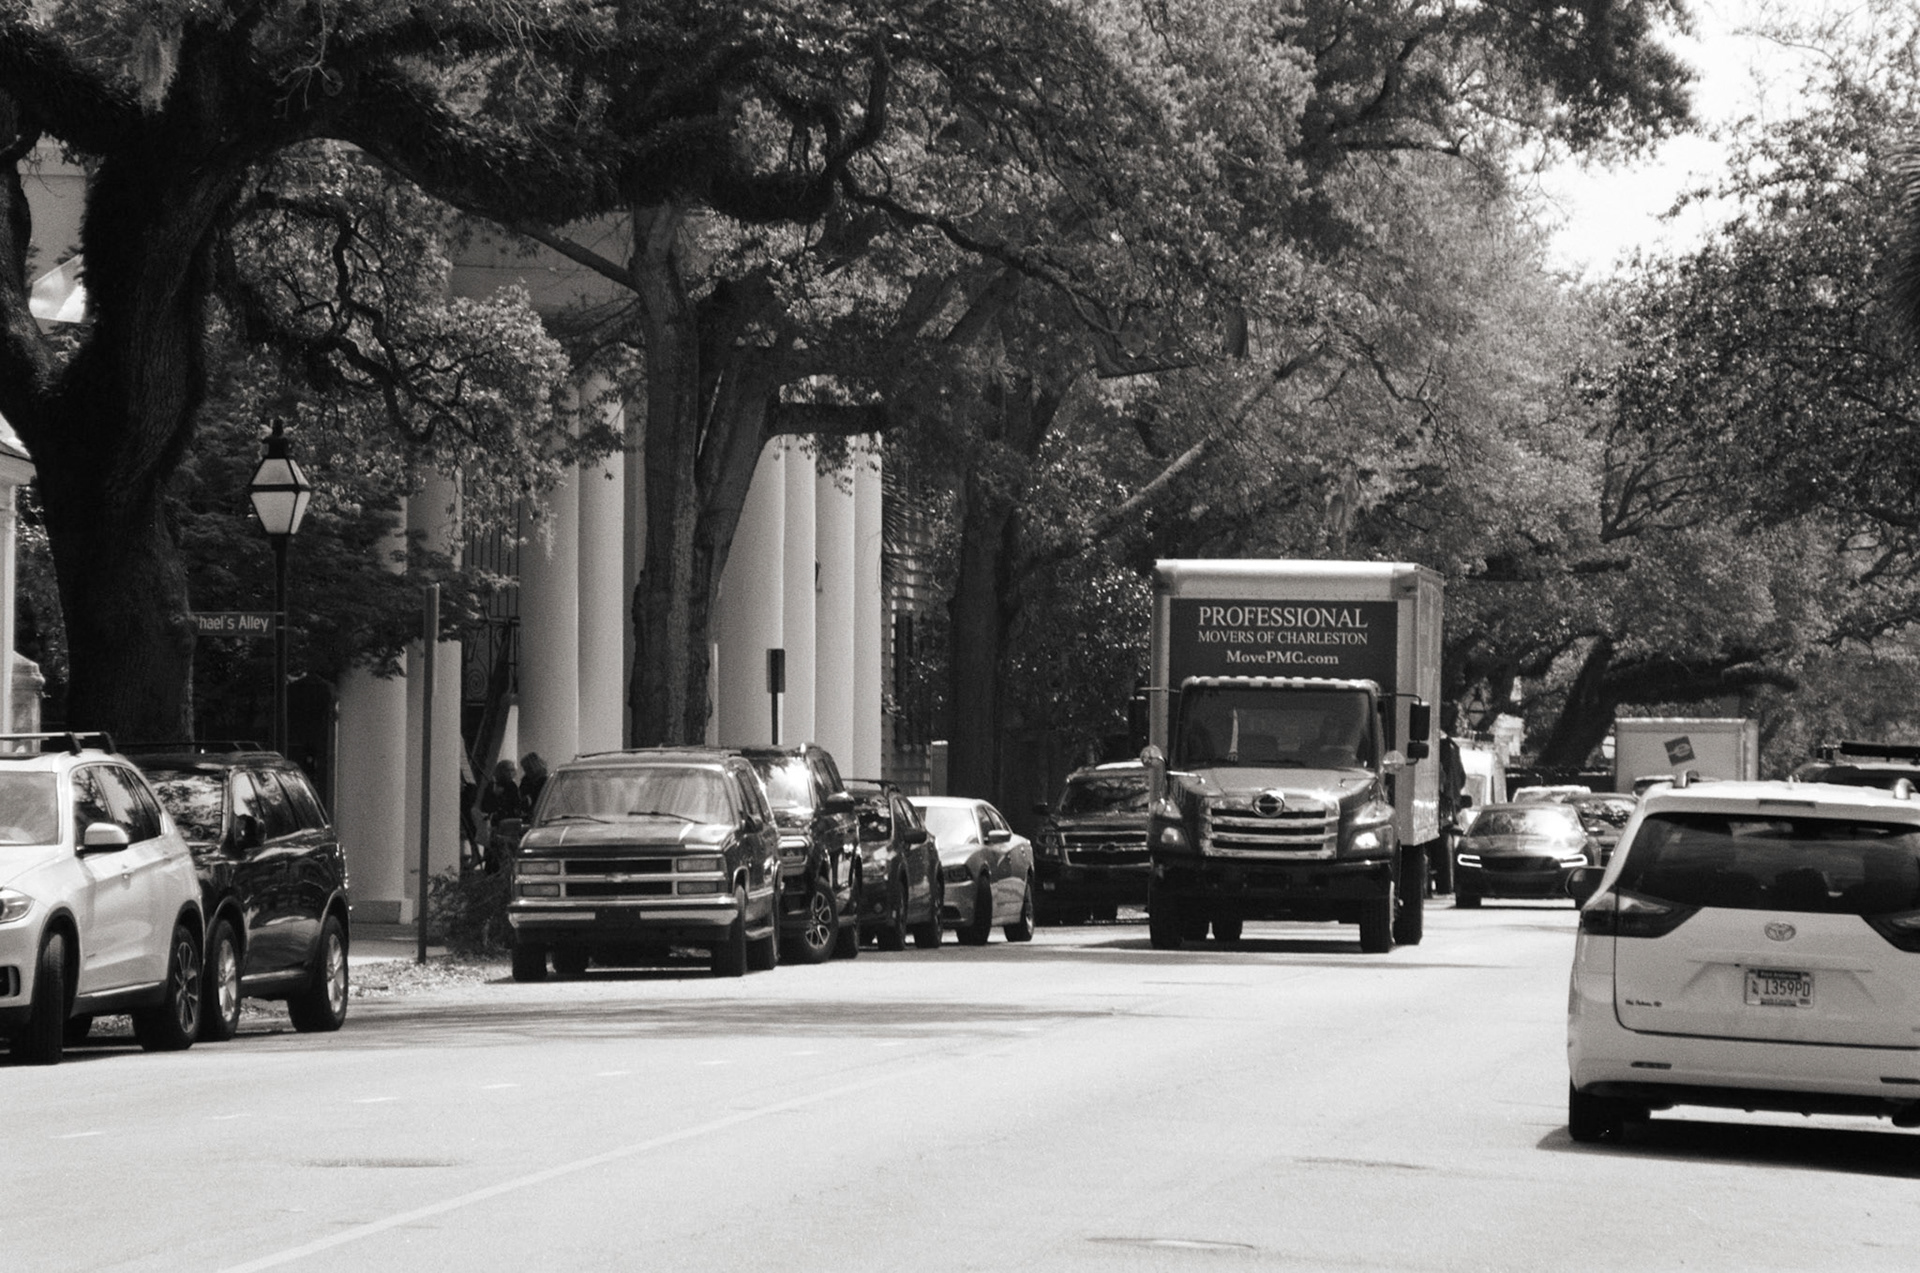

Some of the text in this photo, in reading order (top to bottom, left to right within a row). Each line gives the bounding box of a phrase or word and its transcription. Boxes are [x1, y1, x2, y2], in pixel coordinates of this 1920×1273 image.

[199, 615, 269, 632] hael's Alley
[1198, 606, 1369, 628] PROFESSIONAL
[1198, 630, 1369, 645] MOVERS OF CHARLESTON
[1226, 650, 1340, 665] MovePMC.com
